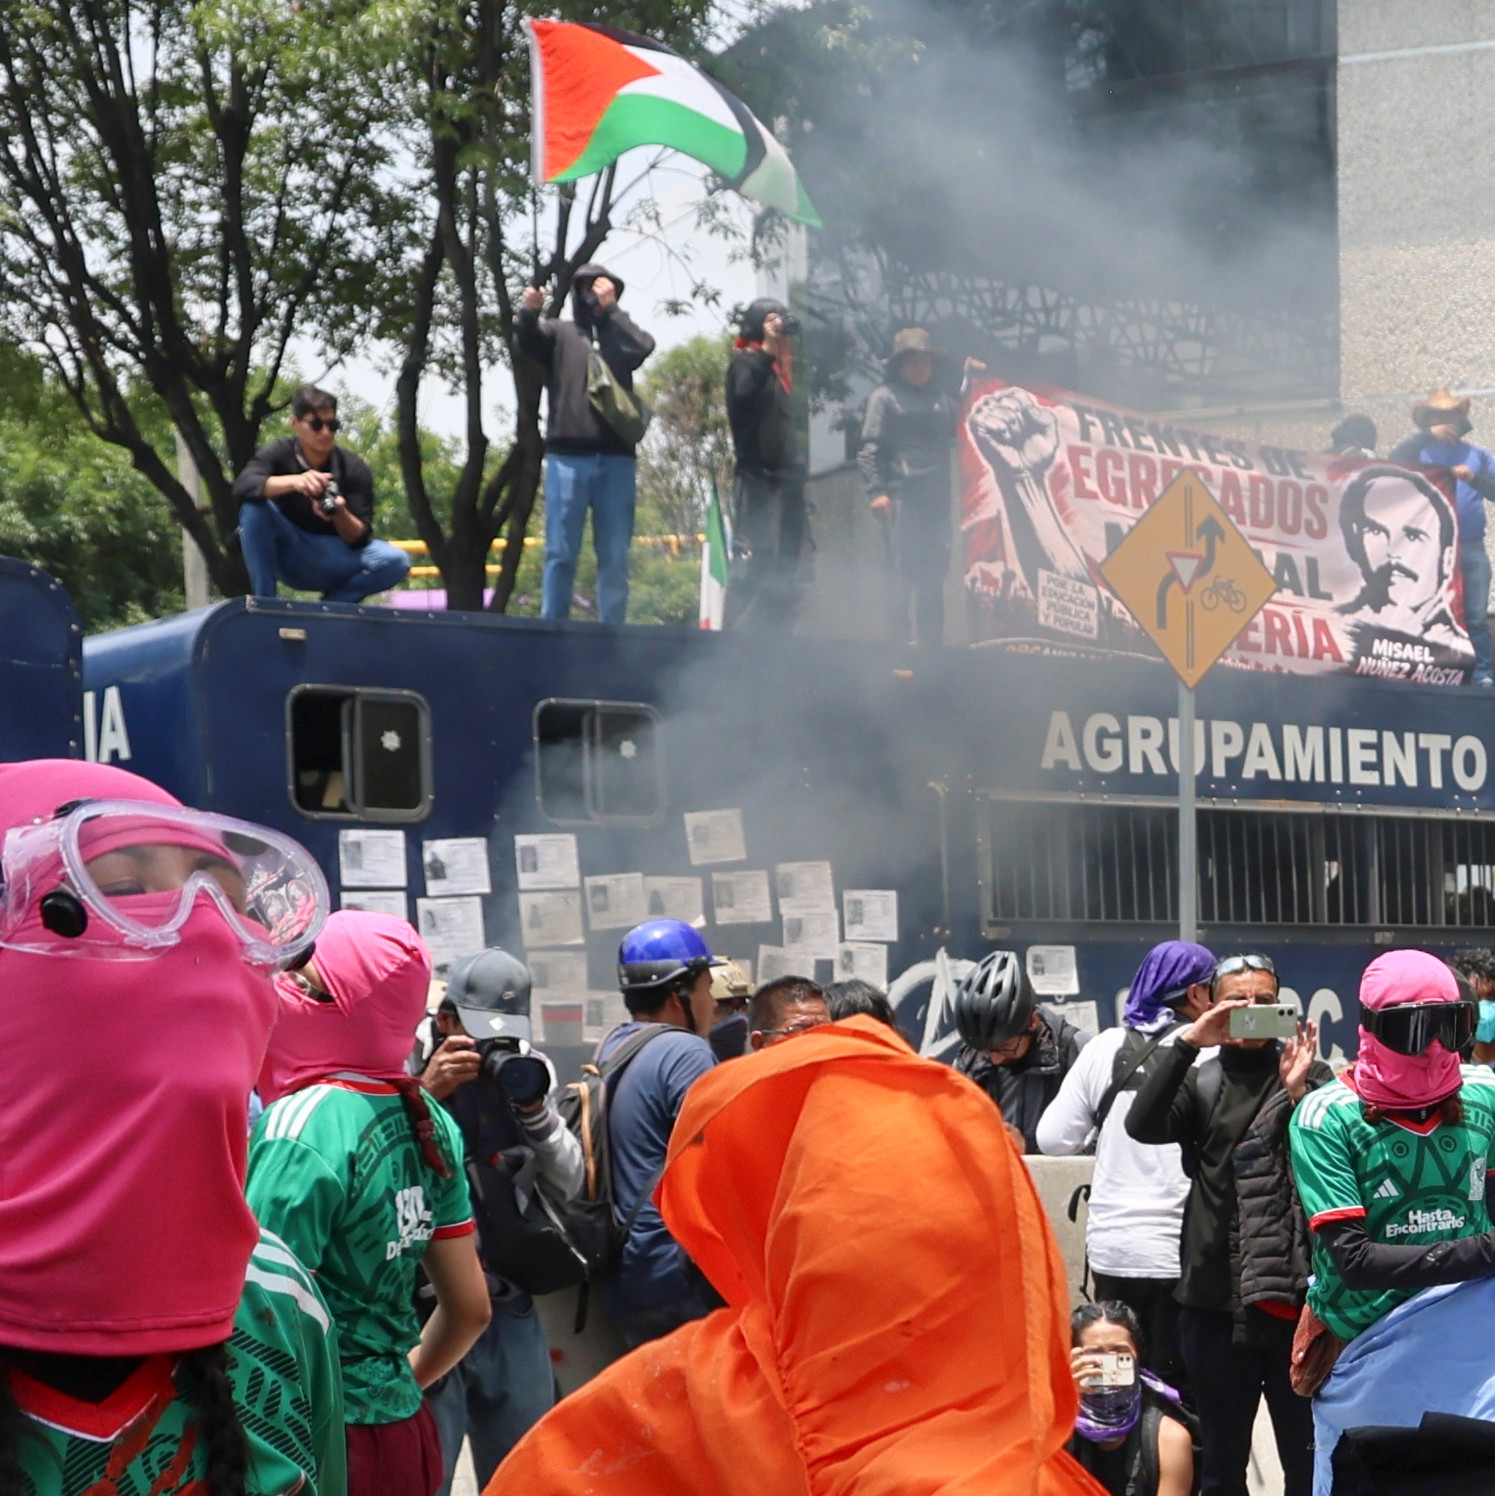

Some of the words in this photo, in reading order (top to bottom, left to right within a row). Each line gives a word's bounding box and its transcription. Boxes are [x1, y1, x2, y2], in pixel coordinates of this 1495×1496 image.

[1071, 403, 1254, 471] FRENTES
[1067, 443, 1329, 541] EGRADOS
[1046, 573, 1067, 591] POR
[1071, 581, 1085, 596] LA
[1053, 615, 1095, 635] POPULAR
[1236, 608, 1346, 664] ERÍA
[1372, 638, 1435, 664] MISAEL
[1411, 662, 1466, 687] ACOSTA
[83, 684, 133, 764] IA
[1039, 709, 1489, 792] AGRUPAMIENTO
[1408, 1208, 1453, 1225] Hasta
